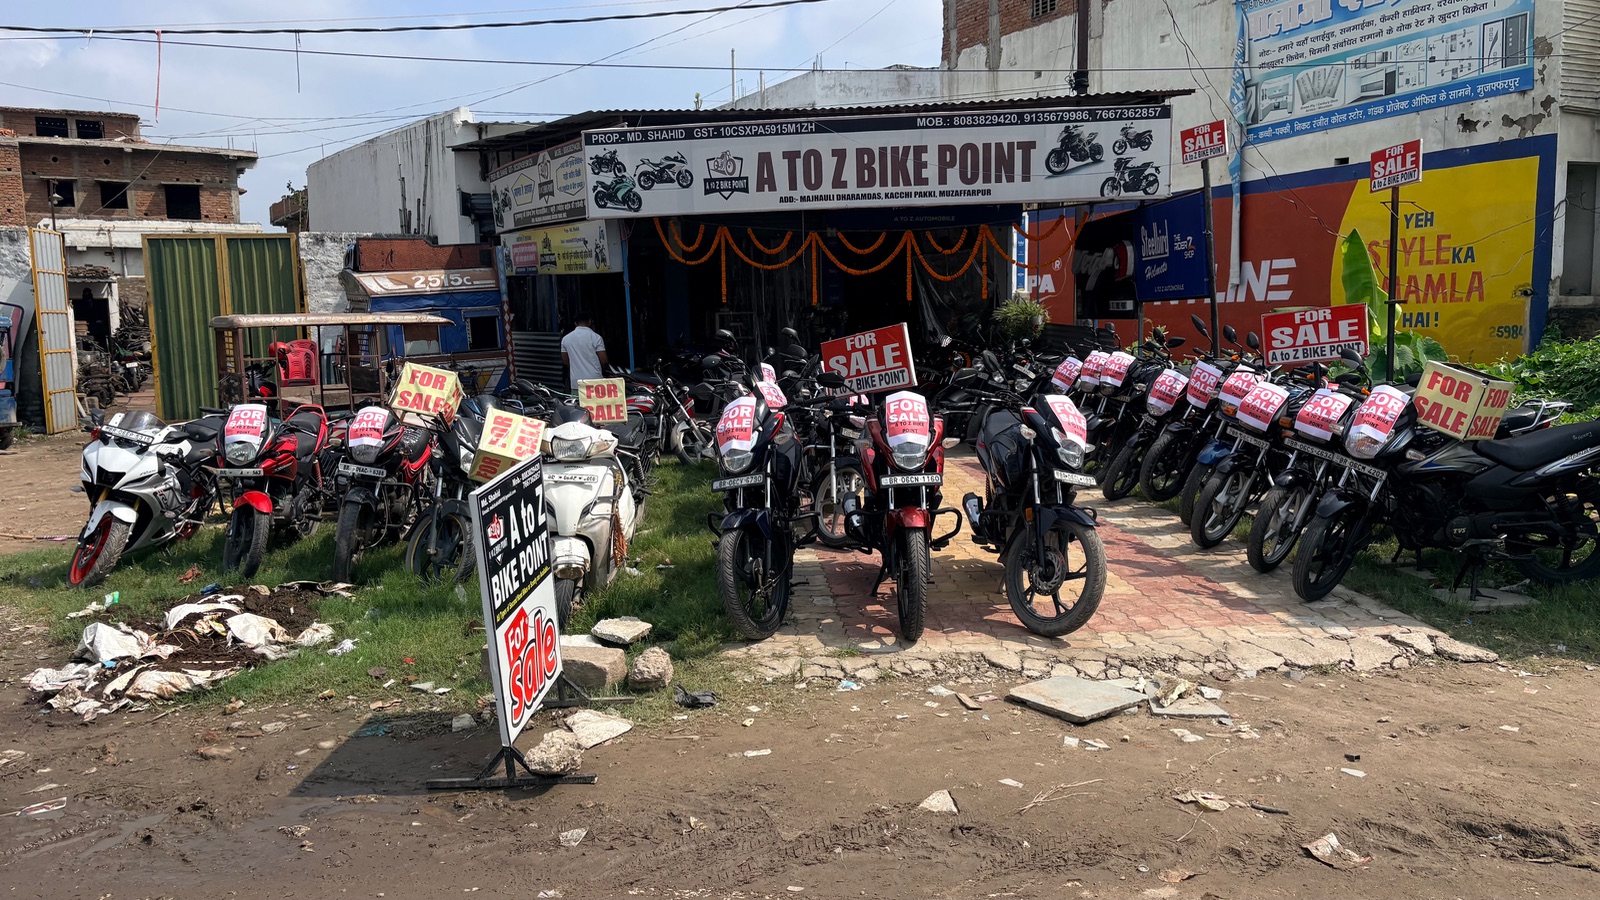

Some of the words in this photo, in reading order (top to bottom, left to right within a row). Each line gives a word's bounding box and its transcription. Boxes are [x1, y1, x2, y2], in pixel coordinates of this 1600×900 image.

[627, 131, 645, 142] MD.
[647, 129, 686, 141] SHAHID
[693, 127, 717, 138] GST-
[720, 122, 815, 136] 10CSXPA5915M1ZH
[953, 114, 1021, 126] 8083829420,
[1024, 110, 1092, 123] 9135679986,
[1095, 107, 1162, 120] 7667362857
[1194, 125, 1210, 136] FOR
[1184, 130, 1222, 153] SALE
[1198, 149, 1209, 158] BIKE
[1210, 145, 1224, 156] POINT
[1386, 145, 1404, 158] FOR
[756, 151, 777, 192] A
[782, 148, 823, 191] TO
[831, 148, 848, 190] Z
[855, 145, 929, 188] BIKE
[937, 141, 1037, 186] POINT
[1373, 151, 1416, 178] SALE
[720, 180, 731, 190] BIKE
[732, 179, 747, 189] POINT
[1373, 181, 1377, 190] A
[1383, 178, 1387, 187] Z
[1388, 175, 1399, 186] BIKE
[1401, 169, 1416, 182] POINT
[800, 194, 835, 203] MAJHAULI
[836, 192, 883, 202] DHARAMDAS,
[884, 191, 913, 200] KACCHI
[914, 190, 937, 200] PAKKI,
[939, 189, 992, 198] MUZAFFARPUR
[1404, 212, 1434, 229] YEH
[1452, 246, 1475, 264] KA
[1295, 309, 1332, 324] FOR
[846, 333, 877, 351] FOR
[1271, 319, 1359, 348] SALE
[829, 343, 902, 378] SALE
[1108, 354, 1130, 366] FOR
[1271, 351, 1278, 362] A
[1281, 351, 1290, 361] to
[1293, 348, 1299, 360] Z
[1302, 345, 1326, 359] BIKE
[1057, 367, 1076, 379] SALE
[1105, 362, 1127, 372] SALE
[409, 369, 447, 391] FOR
[856, 375, 877, 391] BIKE
[879, 369, 906, 387] POINT
[1159, 375, 1183, 389] FOR
[1190, 378, 1213, 393] SALE
[1194, 369, 1216, 386] FOR
[585, 384, 618, 399] FOR
[1155, 383, 1179, 396] SALE
[1427, 371, 1473, 403] FOR
[397, 390, 445, 414] SALE
[1245, 396, 1276, 414] SALE
[1250, 387, 1282, 406] FOR
[1310, 395, 1345, 412] FOR
[1366, 393, 1403, 411] FOR
[1483, 388, 1509, 409] FOR
[231, 410, 262, 420] FOR
[584, 404, 625, 421] SALE
[722, 406, 752, 423] FOR
[889, 400, 925, 413] FOR
[1304, 404, 1339, 421] SALE
[1360, 405, 1397, 421] SALE
[1414, 396, 1468, 434] SALE
[229, 419, 261, 427] SALE
[352, 421, 382, 429] SALE
[356, 412, 385, 423] FOR
[718, 419, 751, 432] SALE
[889, 412, 927, 423] SALE
[1309, 420, 1323, 429] POINT
[1362, 420, 1379, 429] POINT
[1470, 415, 1501, 437] SALE
[476, 456, 501, 480] FOR
[510, 504, 522, 550] A
[521, 498, 535, 538] to
[534, 484, 547, 526] Z
[491, 557, 520, 610] BIKE
[519, 531, 549, 583] POINT
[508, 616, 526, 663] For
